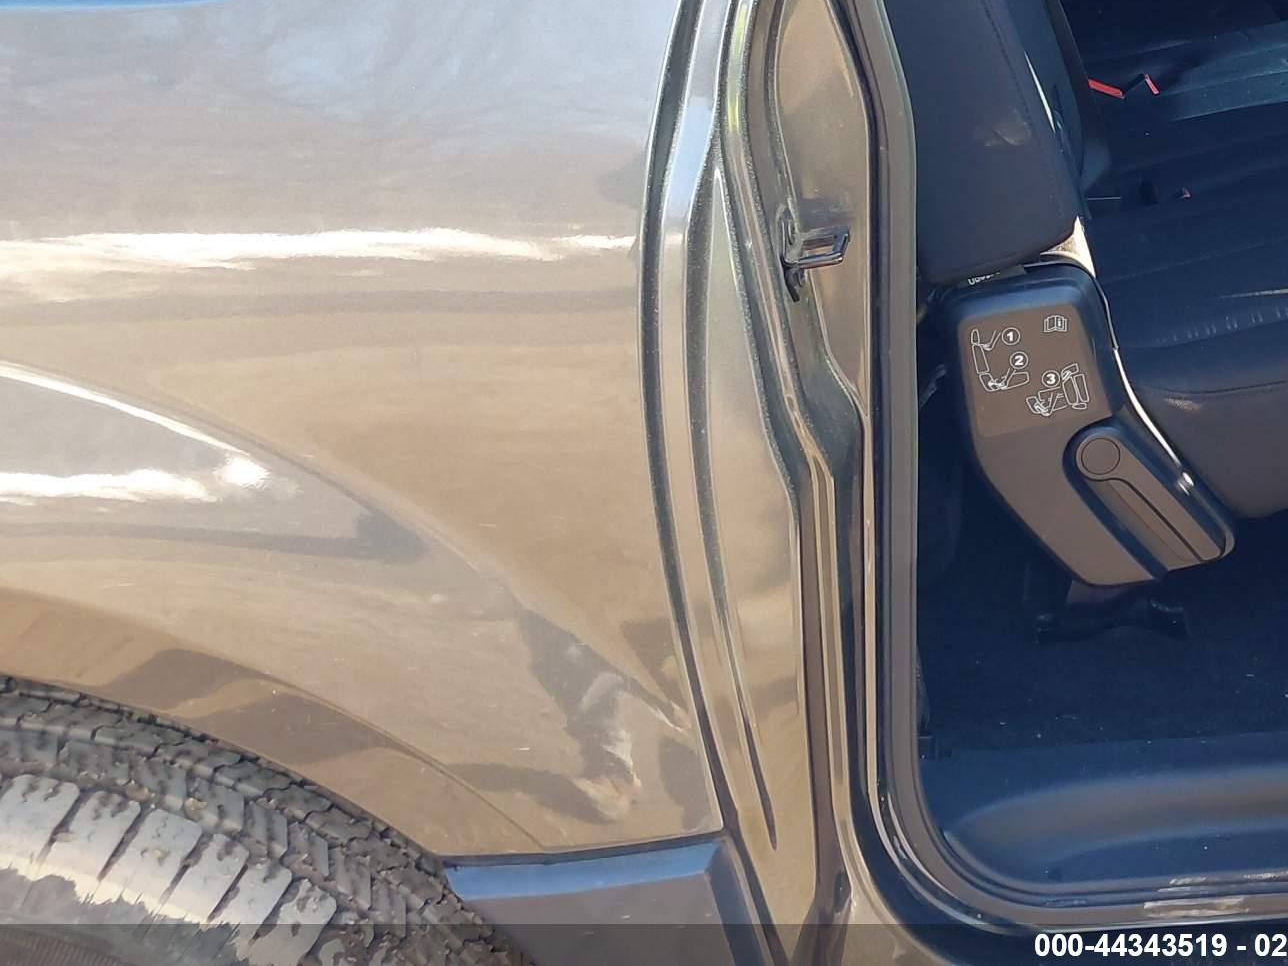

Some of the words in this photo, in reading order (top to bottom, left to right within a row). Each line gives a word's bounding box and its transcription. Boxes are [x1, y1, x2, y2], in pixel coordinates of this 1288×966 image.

[1006, 331, 1014, 342] 1
[1014, 355, 1024, 366] 2
[1046, 375, 1056, 385] 3
